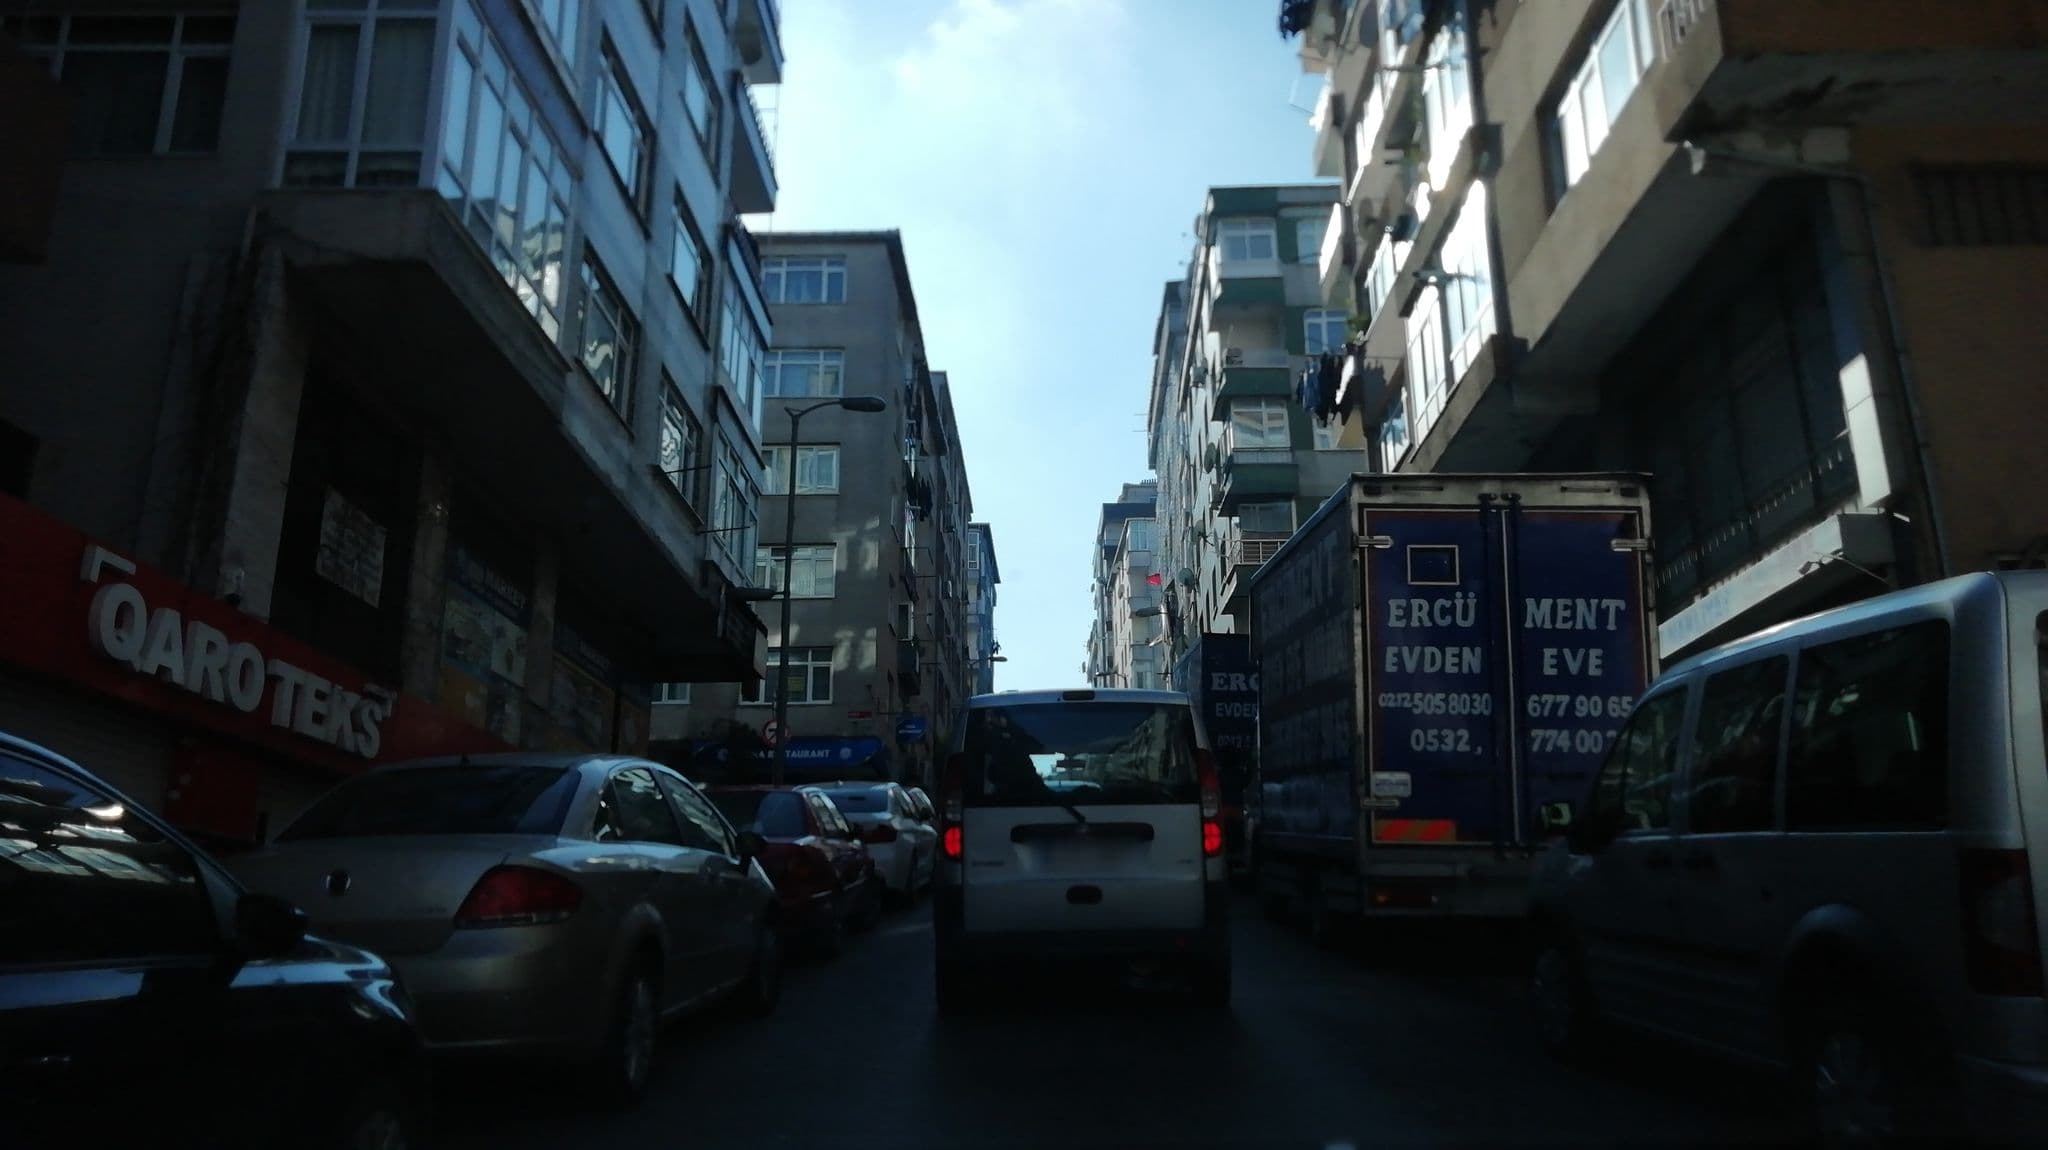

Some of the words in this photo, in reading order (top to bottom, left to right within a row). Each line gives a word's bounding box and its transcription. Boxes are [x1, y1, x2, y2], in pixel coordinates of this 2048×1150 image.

[1387, 590, 1478, 628] ERCÜ
[1523, 597, 1627, 631] MENT
[1384, 645, 1483, 674] EVDEN
[1541, 647, 1604, 677] EVE
[1525, 694, 1571, 718] 677
[1574, 694, 1603, 718] 90
[1529, 728, 1571, 754] 774
[1574, 728, 1604, 754] 00
